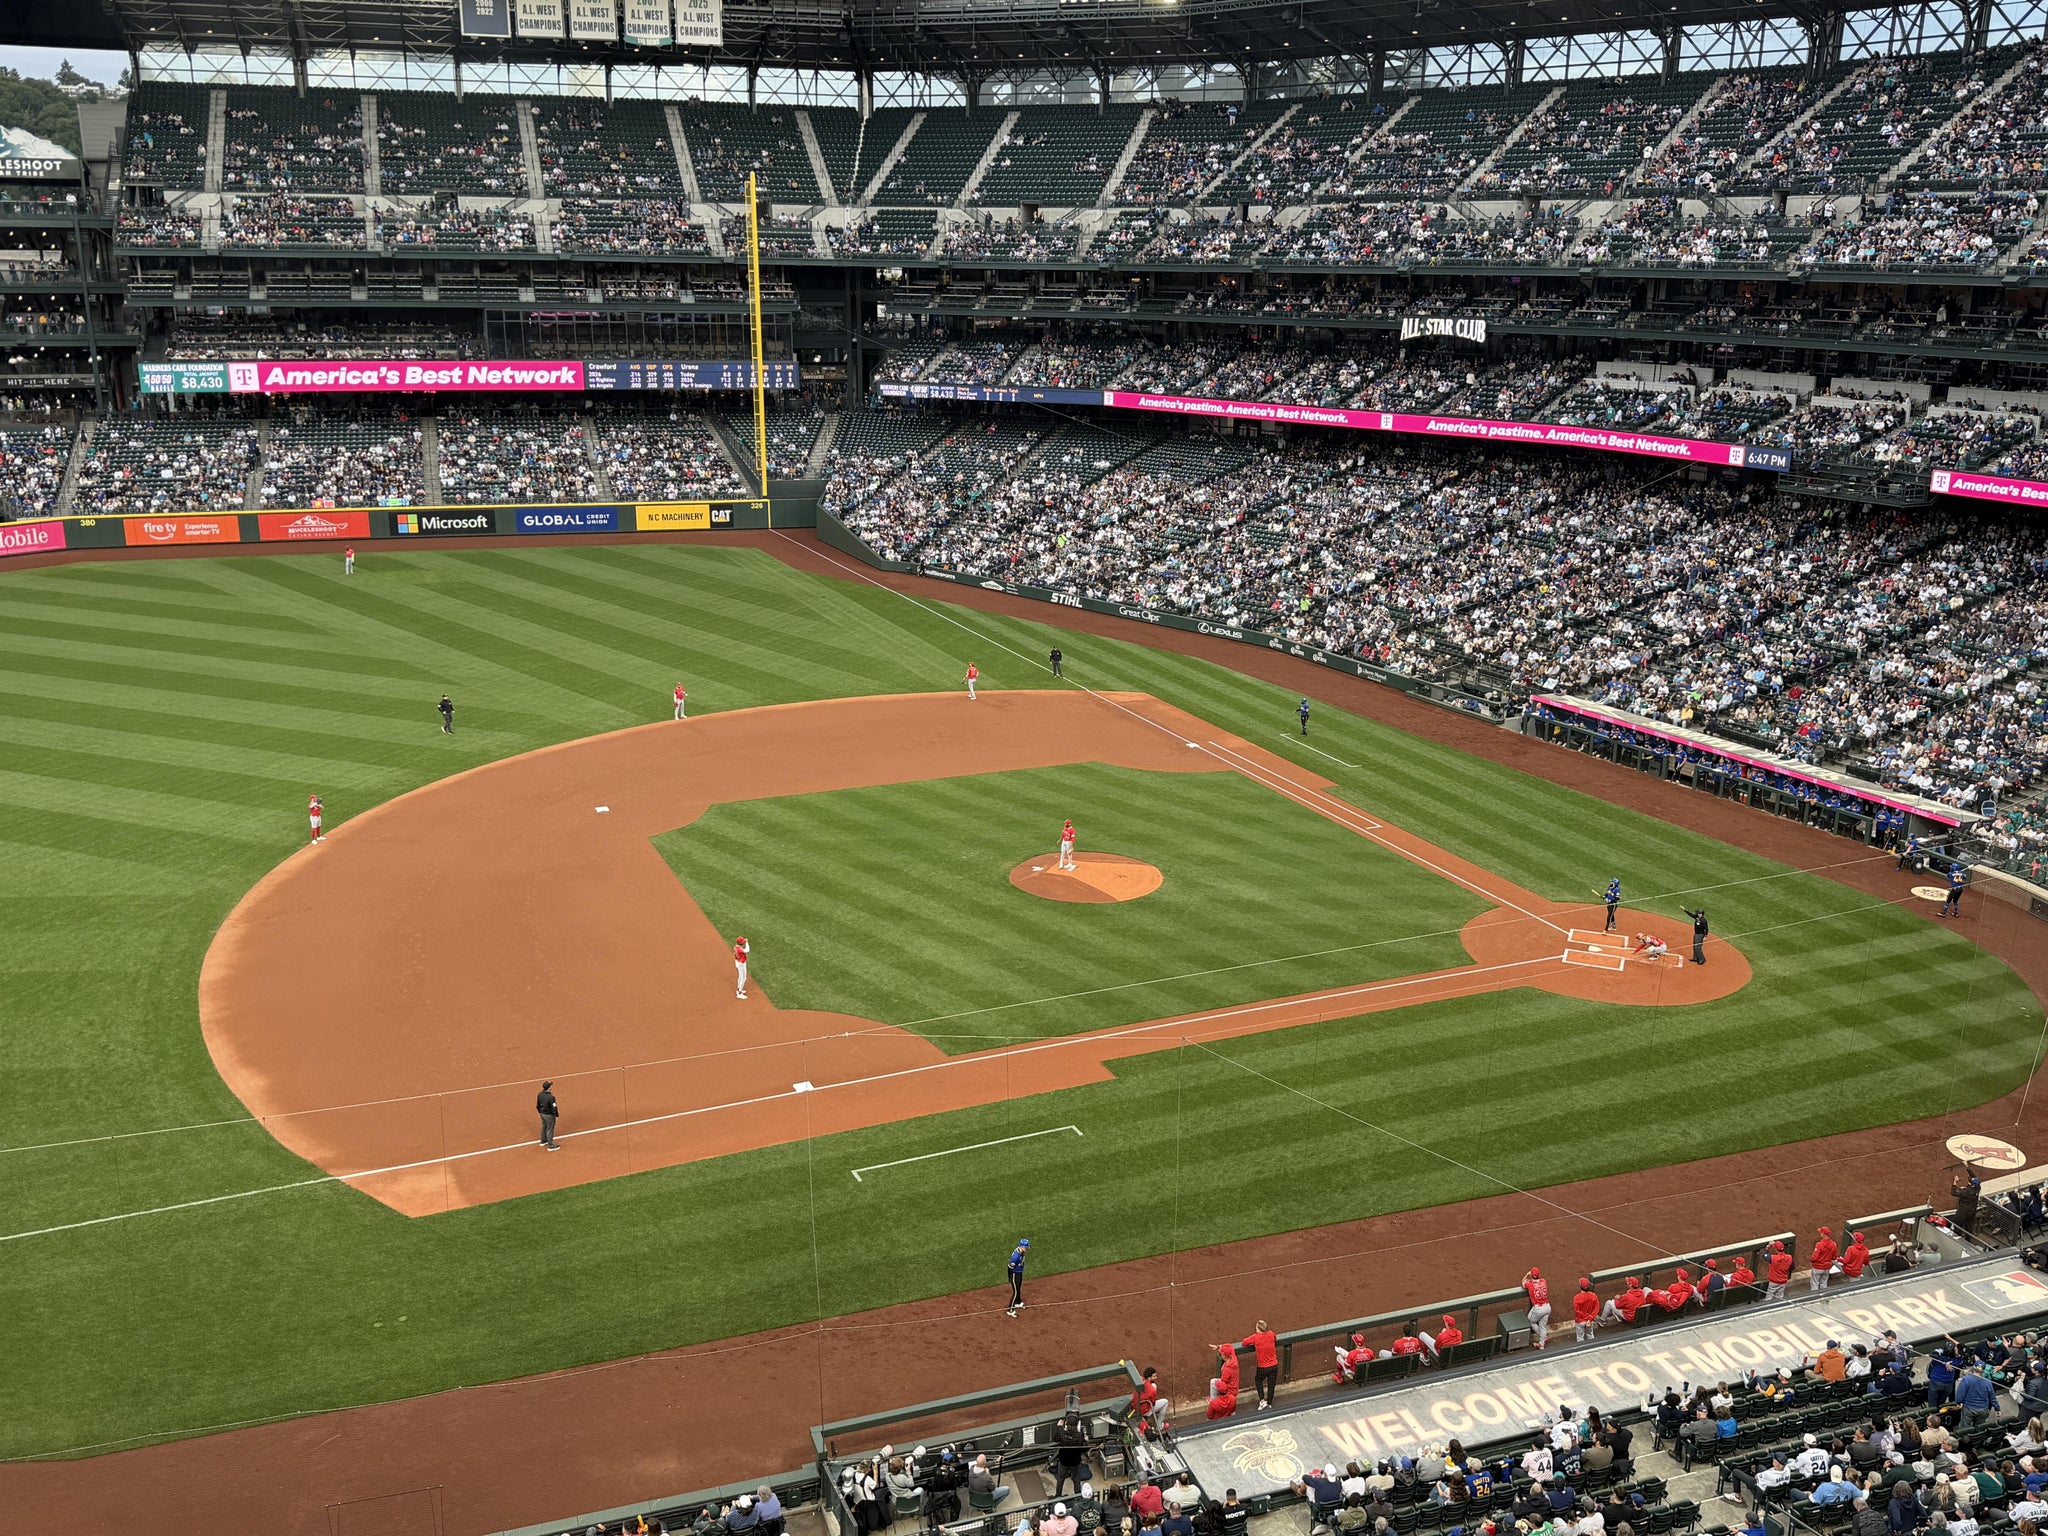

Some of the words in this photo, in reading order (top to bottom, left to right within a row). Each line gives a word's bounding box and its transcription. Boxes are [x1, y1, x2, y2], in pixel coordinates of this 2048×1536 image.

[476, 8, 494, 16] 2022
[536, 5, 556, 16] WEST
[590, 7, 609, 18] WEST
[644, 10, 663, 20] WEST
[520, 18, 562, 30] CHAMPIONS
[696, 13, 714, 23] WEST
[573, 21, 615, 33] CHAMPIONS
[627, 23, 668, 35] CHAMPIONS
[680, 26, 718, 37] CHAMPIONS
[1456, 318, 1487, 343] CLUB
[265, 367, 400, 386] America's
[405, 366, 462, 384] Best
[467, 366, 576, 384] Network
[181, 377, 223, 389] $8,430
[1139, 397, 1183, 411] America's
[1226, 403, 1275, 418] America's
[1276, 407, 1299, 420] Best
[1300, 410, 1349, 424] Network.
[1426, 419, 1487, 435] America's
[1546, 428, 1608, 445] America's
[1608, 434, 1635, 449] Best
[1636, 438, 1692, 455] Network.
[1748, 453, 1769, 465] 6:47
[1770, 455, 1786, 467] PM
[1952, 479, 2019, 497] America's
[524, 515, 584, 526] GLOBAL
[662, 512, 704, 521] MACHINERY
[711, 509, 732, 522] CAT
[80, 519, 96, 527] 380
[144, 522, 164, 533] fire
[165, 522, 177, 533] tv
[422, 515, 488, 530] Microsoft
[1051, 592, 1083, 608] STIHL
[1119, 607, 1141, 618] Great
[1141, 610, 1160, 622] Clips
[1210, 626, 1242, 639] LEXUS
[1318, 1376, 1582, 1457] WELCOME
[1573, 1360, 1652, 1399] TO
[1644, 1316, 1861, 1382] T-MOBILE
[1847, 1289, 1978, 1337] PARK
[1538, 1459, 1552, 1474] 44
[1811, 1461, 1826, 1475] 24
[1477, 1484, 1490, 1497] 24
